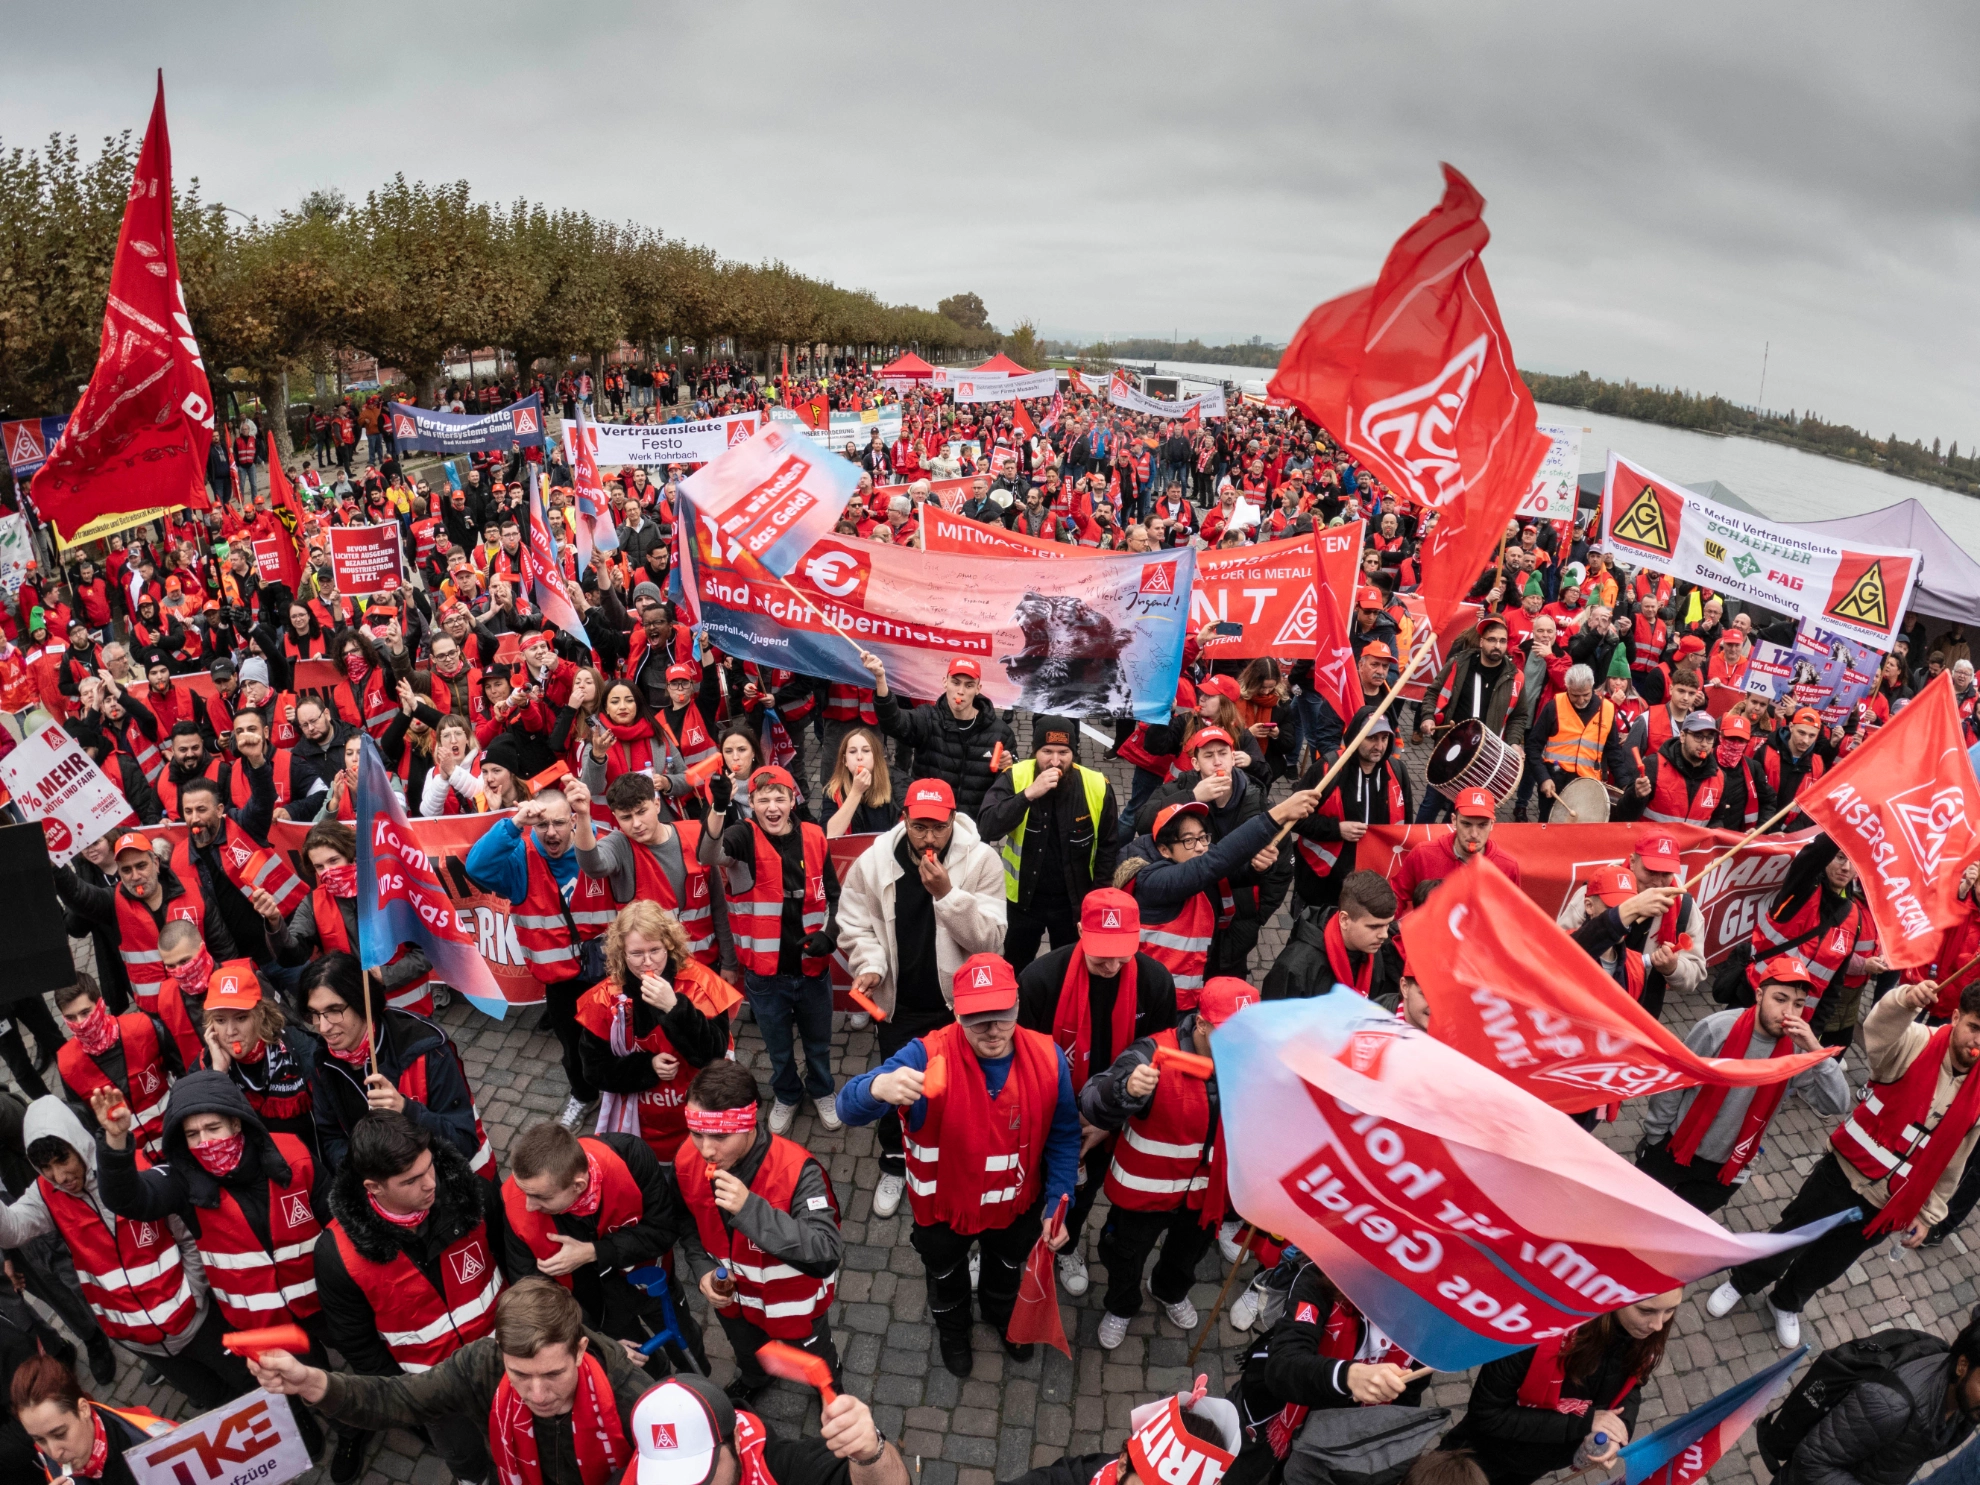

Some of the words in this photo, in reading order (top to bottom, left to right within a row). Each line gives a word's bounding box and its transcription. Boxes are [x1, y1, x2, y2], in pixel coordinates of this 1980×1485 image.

[489, 421, 513, 434] GmbH
[601, 423, 722, 437] Vertrauensleute
[641, 438, 683, 450] Festo
[628, 452, 652, 461] Werk
[654, 450, 698, 461] Rohrbach
[766, 462, 806, 500] holen
[72, 523, 111, 541] ertrauensleute
[749, 525, 778, 551] das
[772, 493, 813, 526] Geld!
[1704, 507, 1740, 529] Metall
[1742, 521, 1838, 556] Vertrauensleute
[346, 545, 368, 553] BEVOR
[368, 543, 380, 551] DIE
[1707, 521, 1813, 565] SCHAEFFLER
[335, 552, 360, 560] LICHTER
[360, 548, 395, 560] AUSGEHEN:
[345, 556, 389, 567] BEZAHLBARER
[340, 562, 394, 574] INDUSTRIESTROM
[805, 550, 861, 598] €
[1142, 564, 1171, 592] IGM
[1221, 568, 1245, 580] DER
[1248, 568, 1261, 580] IG
[1264, 567, 1313, 580] METALL
[352, 572, 380, 585] JETZT.
[1695, 564, 1746, 591] Standort
[1749, 582, 1800, 613] Homburg
[1767, 569, 1804, 591] FAG
[705, 577, 750, 606] sind
[822, 598, 988, 651] übertrieben!
[1820, 615, 1889, 642] HOMBURG-SAARPFALZ
[1751, 661, 1764, 670] Wir
[1763, 663, 1791, 676] fordern:
[1750, 681, 1767, 693] 170
[36, 752, 90, 801] MEHR
[42, 795, 65, 816] NÖTIG
[62, 784, 79, 800] UND
[78, 769, 98, 789] FAIR!
[100, 797, 119, 813] GEWINNT
[408, 889, 450, 929] das
[145, 1399, 282, 1485] TKE
